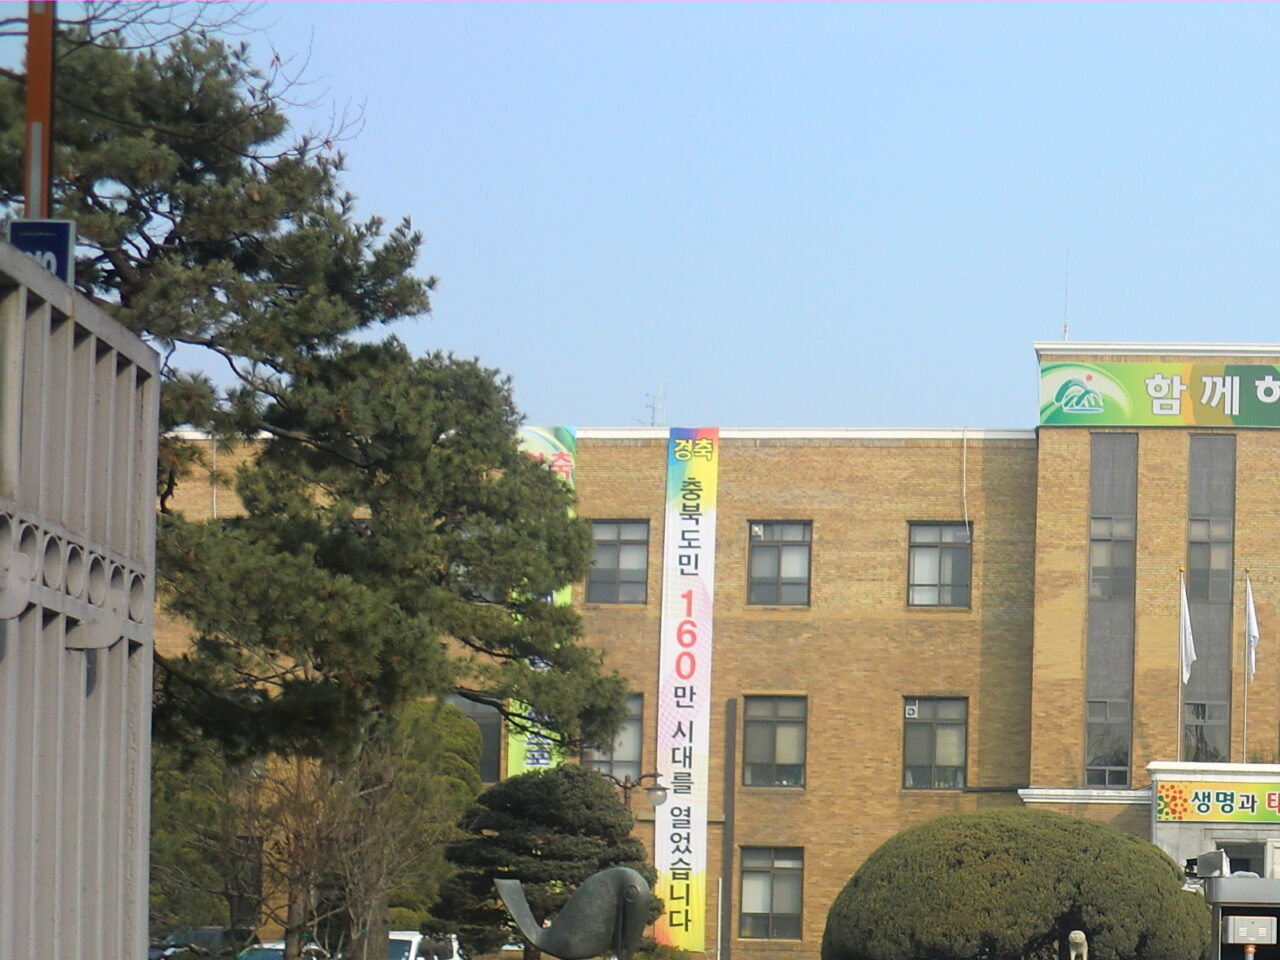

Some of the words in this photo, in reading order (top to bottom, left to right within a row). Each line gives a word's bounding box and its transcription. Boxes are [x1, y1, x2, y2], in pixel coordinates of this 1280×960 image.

[673, 438, 714, 462] 경축
[678, 477, 703, 577] 충북도민
[673, 588, 698, 709] 160만
[670, 719, 695, 795] 시대를
[1191, 790, 1258, 815] 생명과
[668, 805, 693, 933] 열었습니다
